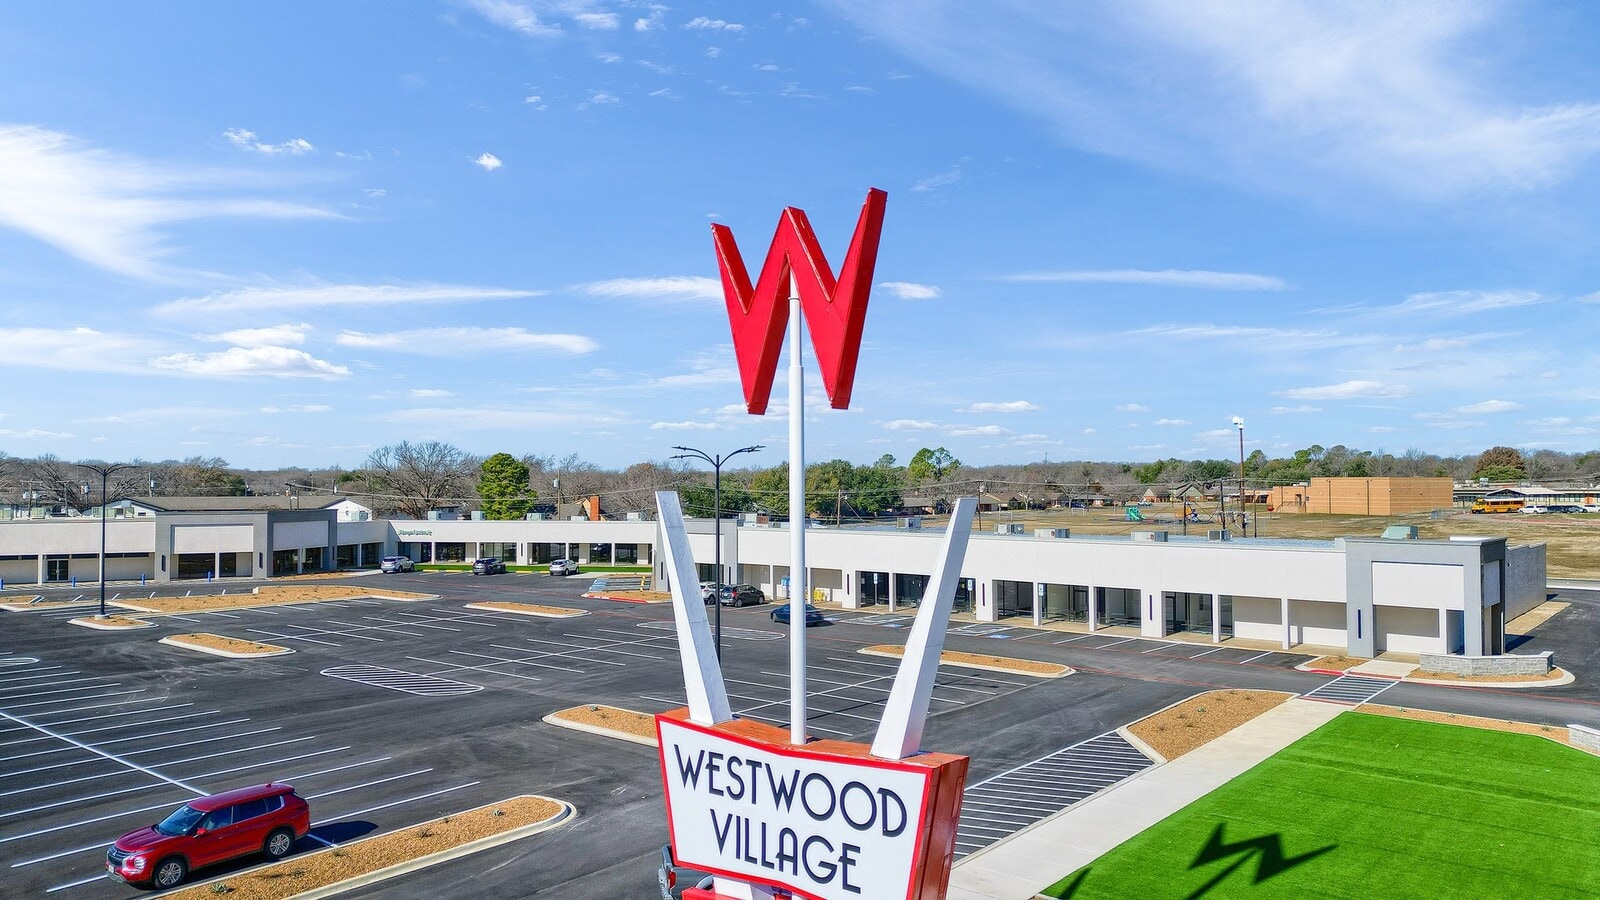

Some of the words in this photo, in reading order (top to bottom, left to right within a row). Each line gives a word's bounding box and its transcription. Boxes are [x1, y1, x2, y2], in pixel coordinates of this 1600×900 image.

[711, 187, 888, 415] W
[673, 744, 908, 838] WESTWOOD
[709, 808, 862, 894] VILLAGE
